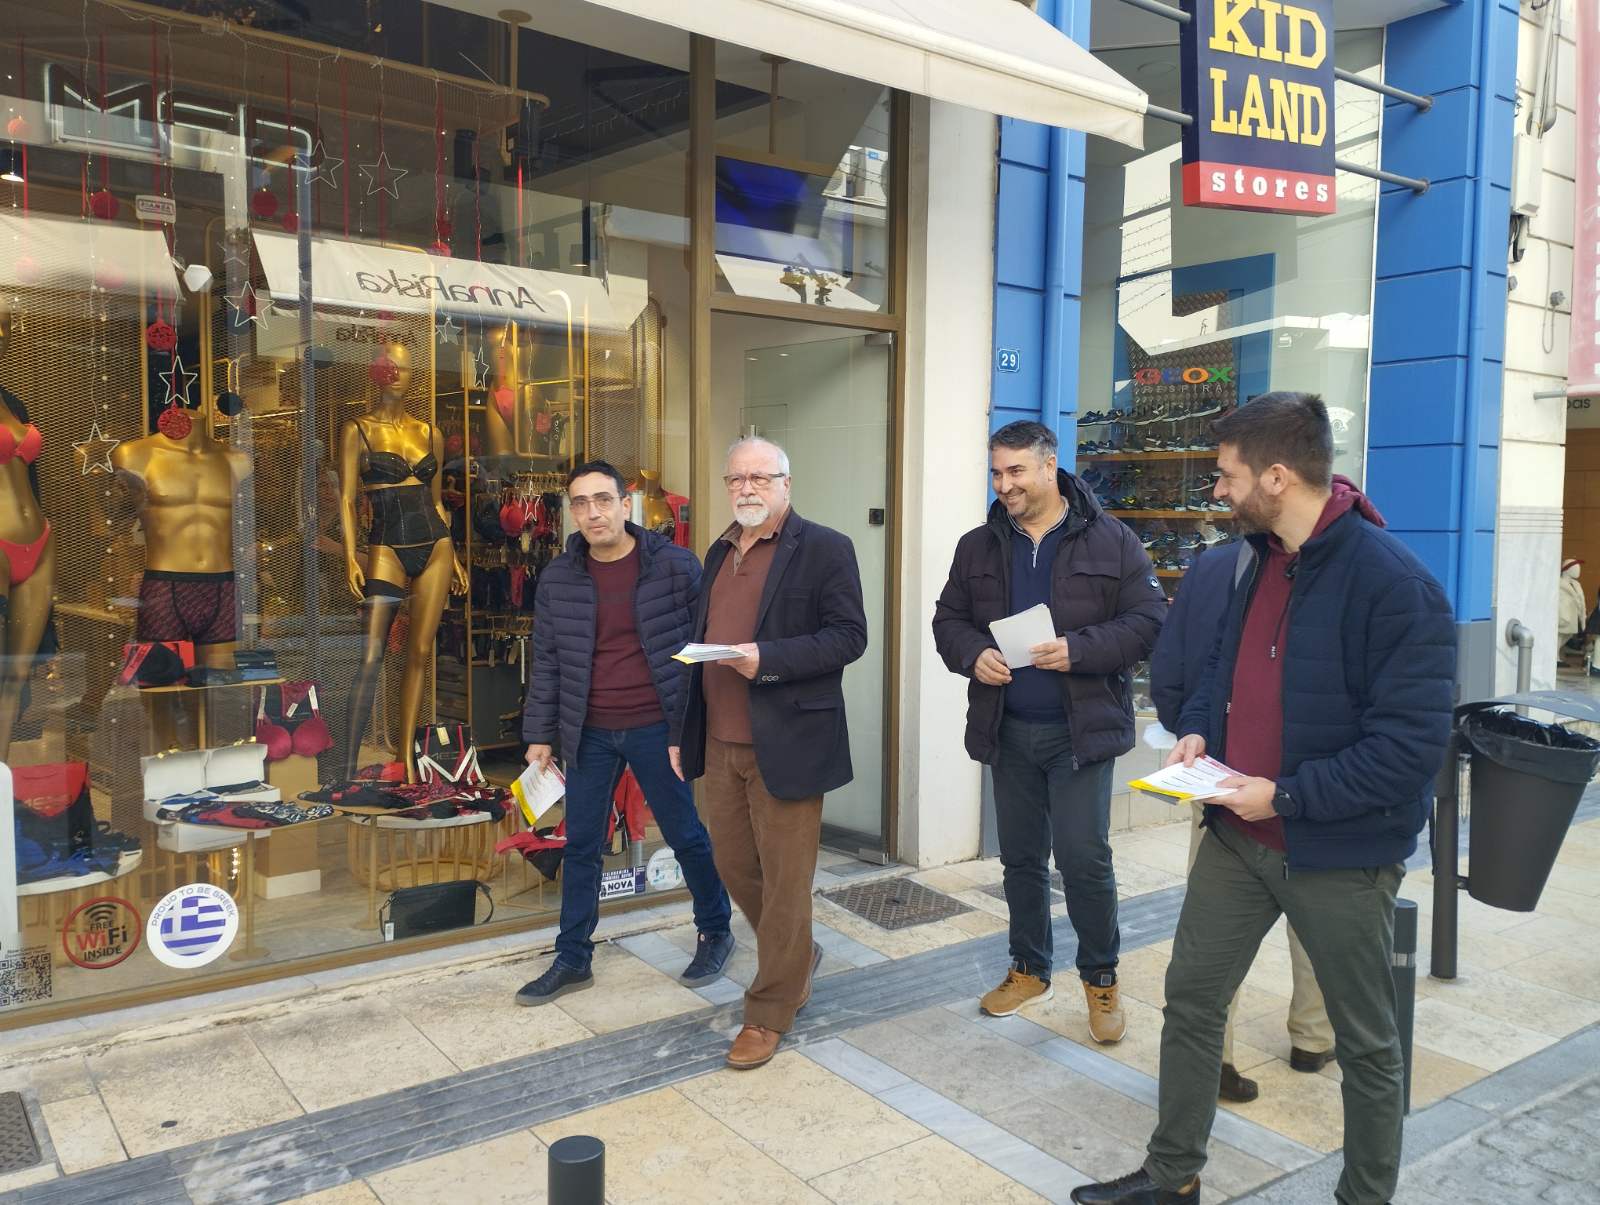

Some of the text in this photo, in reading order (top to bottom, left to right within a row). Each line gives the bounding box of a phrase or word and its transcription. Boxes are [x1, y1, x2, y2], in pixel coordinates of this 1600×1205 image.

[1209, 0, 1327, 69] KID
[1210, 67, 1327, 147] LAND
[1212, 168, 1329, 202] stores
[1001, 353, 1016, 367] 29
[1136, 367, 1233, 385] GEOX
[1142, 384, 1223, 394] RESPIRA
[607, 880, 634, 891] NOVA
[152, 886, 236, 927] PROUD TO BE GREEK
[90, 920, 114, 931] FREE
[76, 925, 128, 951] WiFi
[84, 945, 122, 962] INSIDE
